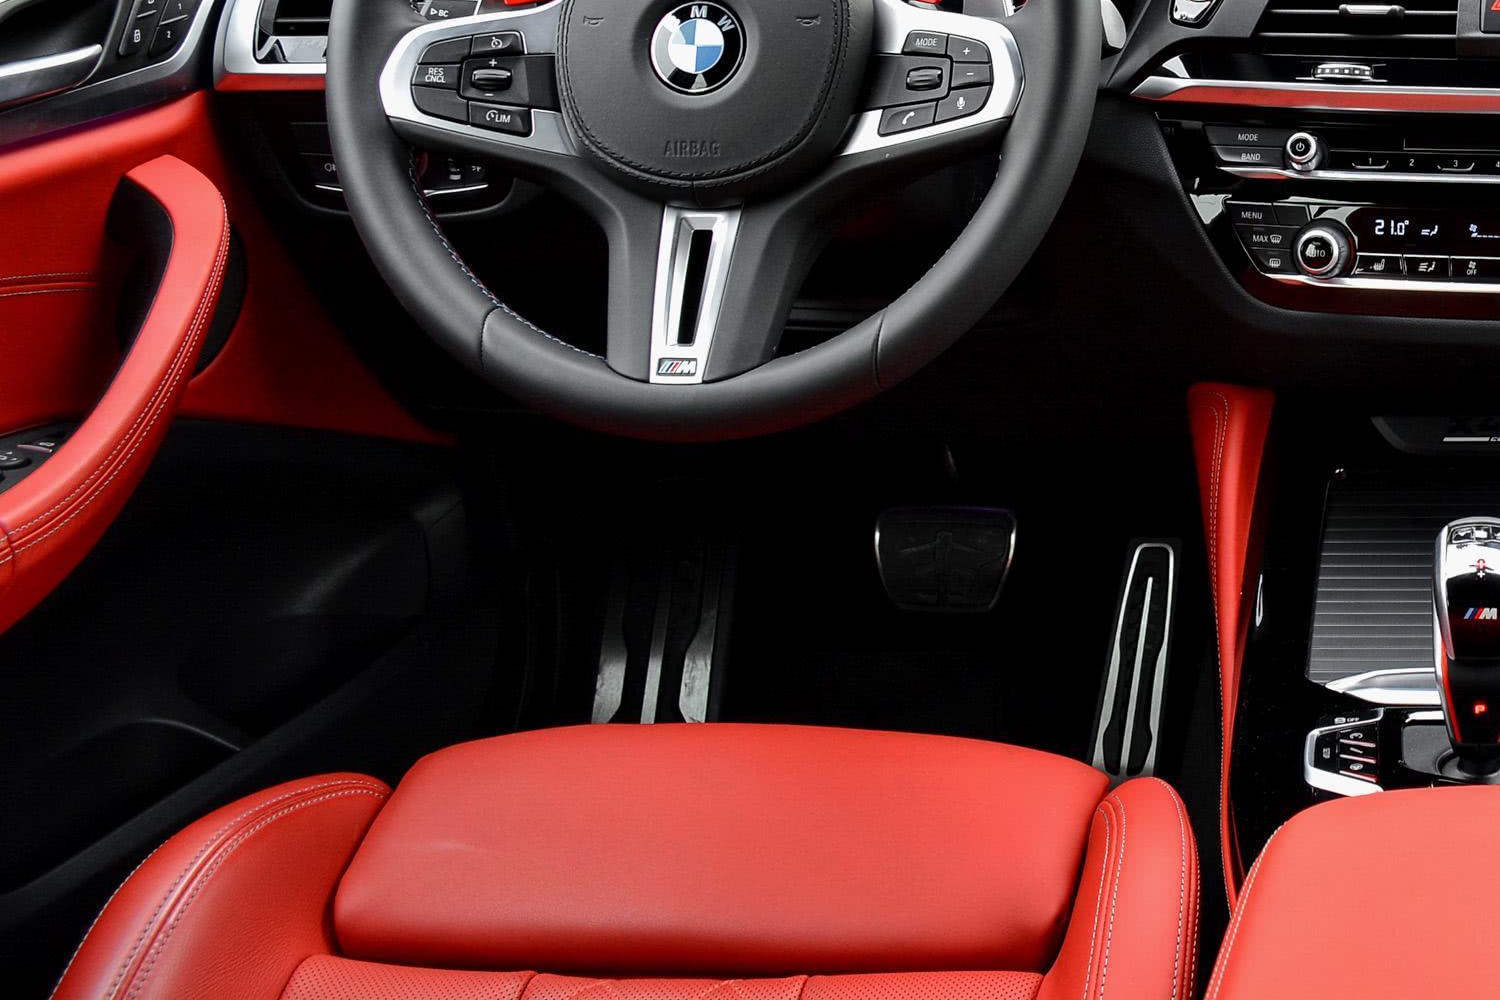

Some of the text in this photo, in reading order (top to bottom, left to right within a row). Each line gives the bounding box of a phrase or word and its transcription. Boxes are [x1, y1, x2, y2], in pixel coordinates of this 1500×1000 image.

[915, 38, 938, 47] MODE
[428, 67, 444, 75] RES
[425, 75, 446, 83] CNCL
[495, 115, 511, 123] LIM
[1238, 133, 1259, 141] MODE
[664, 141, 721, 157] AIRBAG
[1241, 153, 1261, 161] BAND
[1368, 157, 1372, 165] 1
[1409, 158, 1415, 167] 2
[1453, 159, 1458, 168] 3
[1495, 160, 1500, 168] 4
[1241, 211, 1263, 219] MENU
[1252, 234, 1269, 243] MAX
[1466, 268, 1478, 276] OFF
[1475, 704, 1485, 714] P
